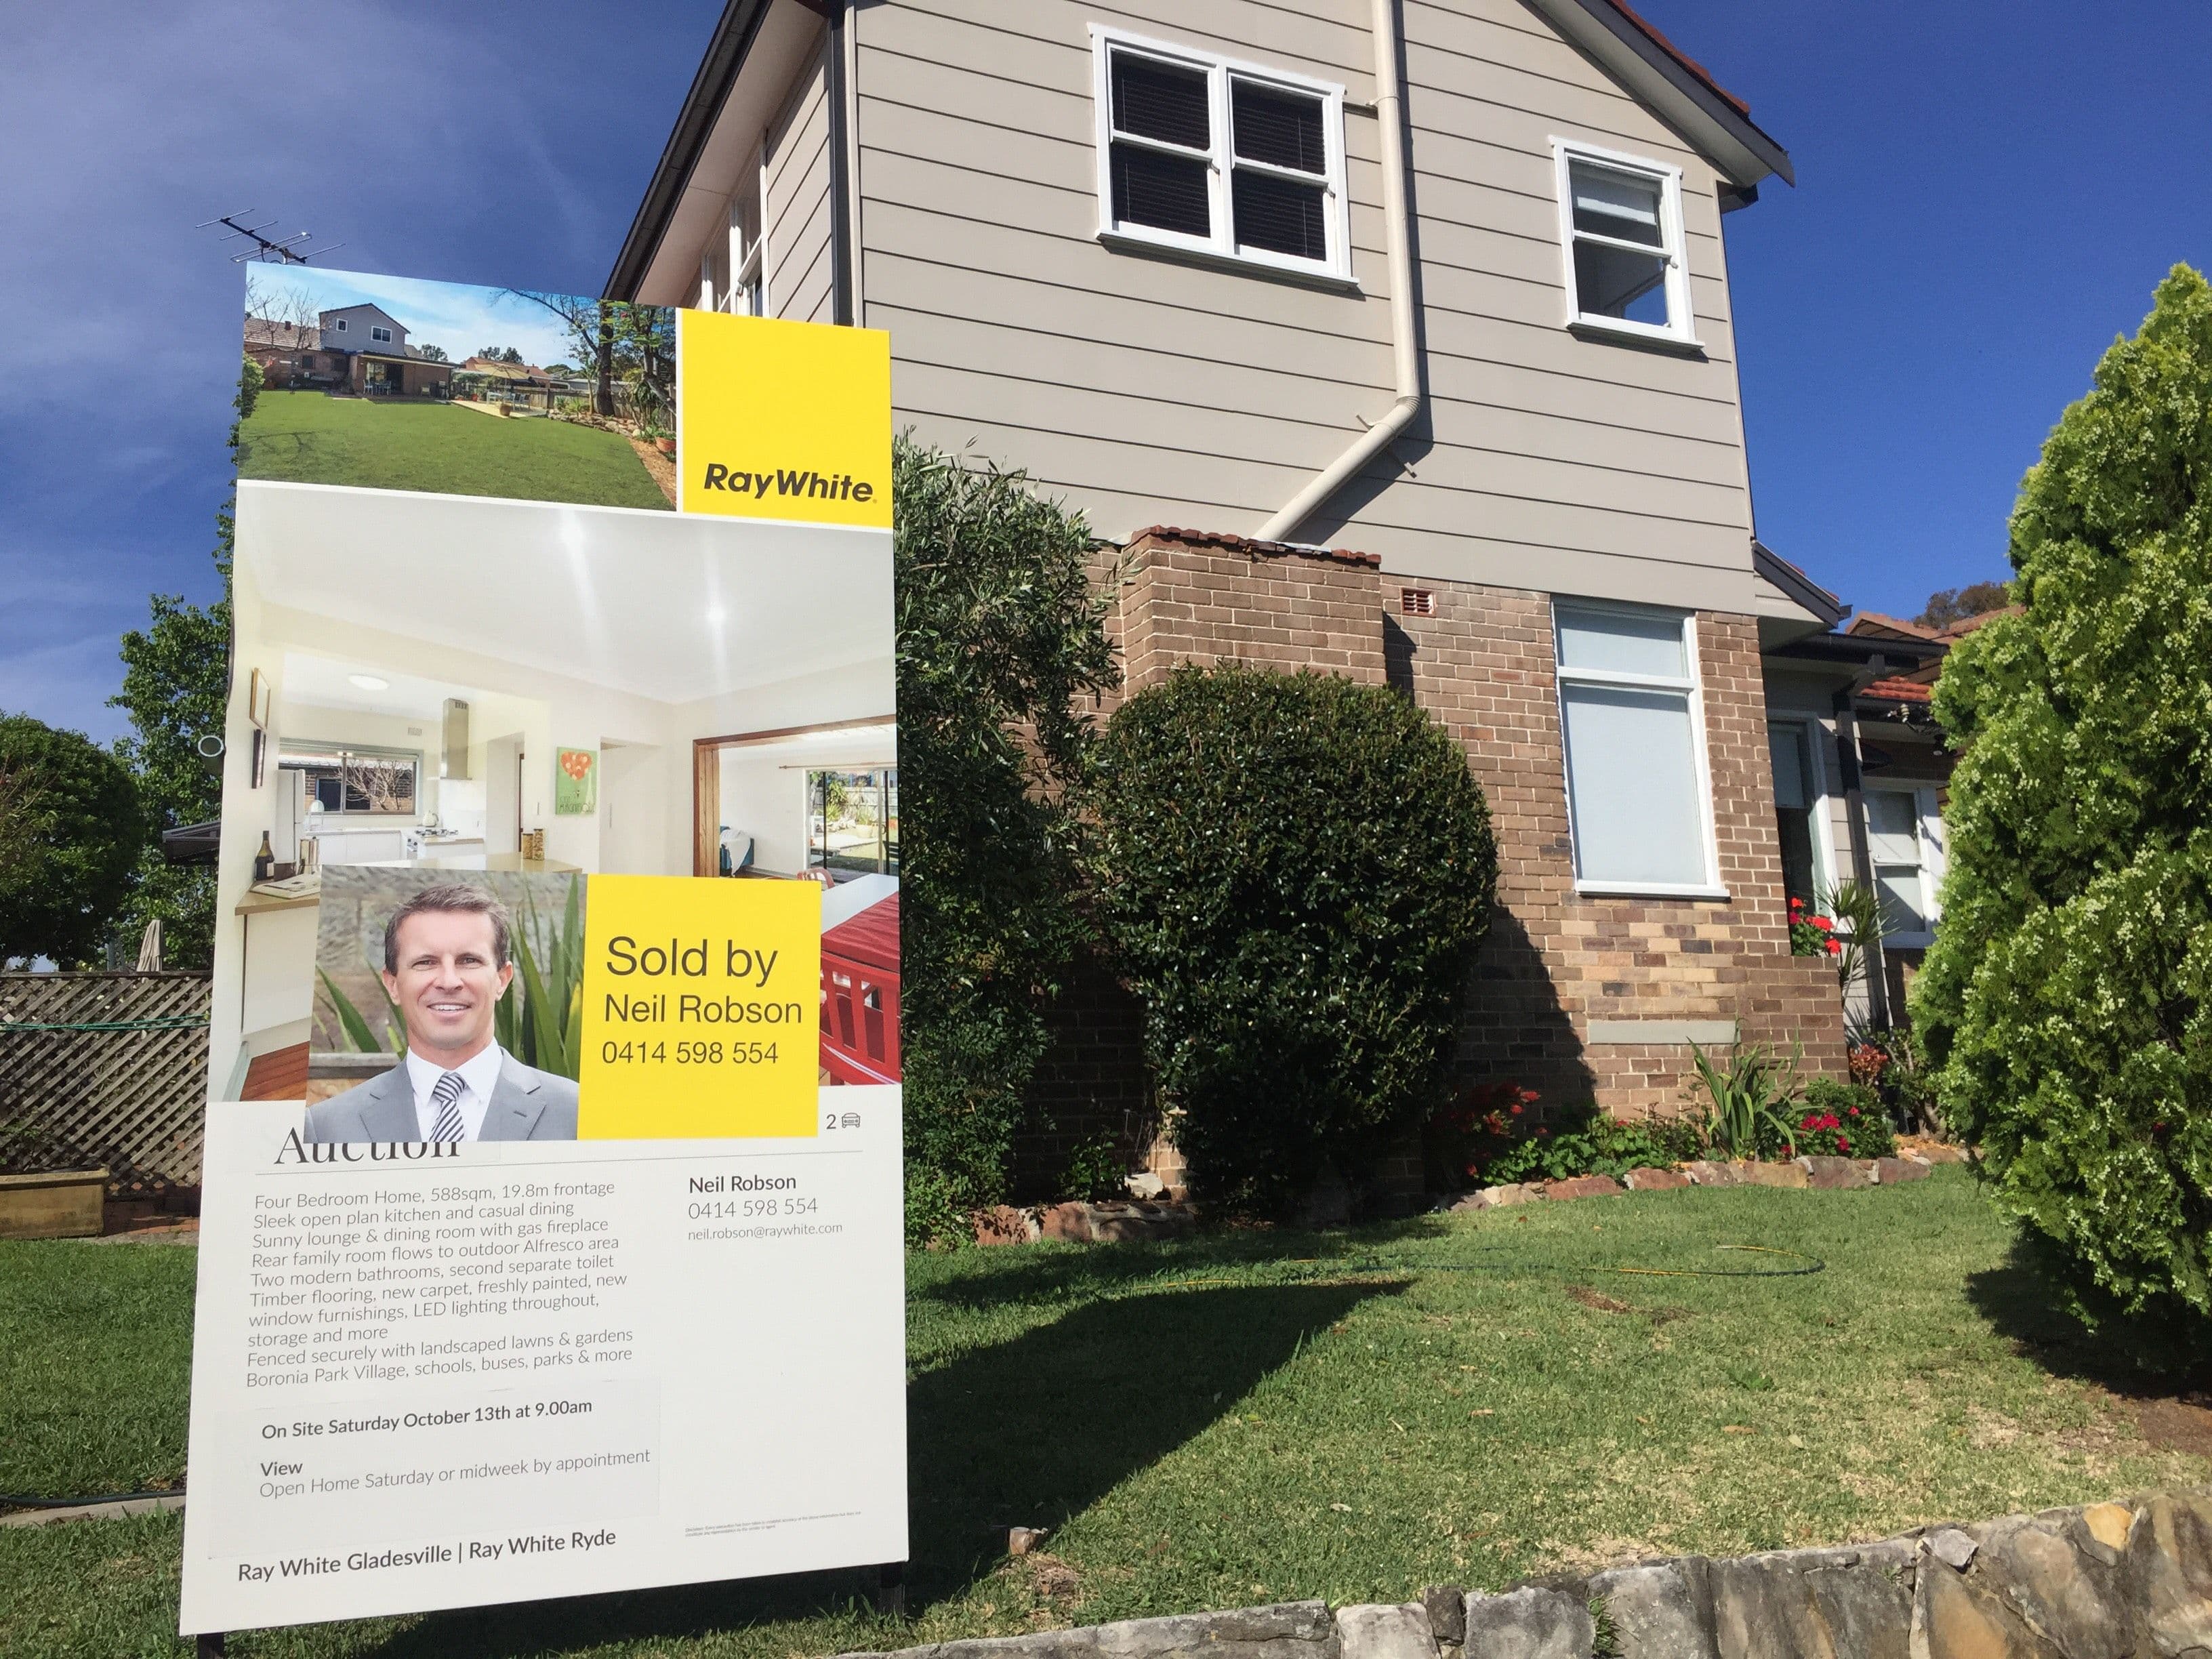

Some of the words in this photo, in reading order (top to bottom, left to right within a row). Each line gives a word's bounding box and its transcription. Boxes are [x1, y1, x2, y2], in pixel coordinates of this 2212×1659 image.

[606, 935, 708, 977] Sold
[726, 939, 779, 988] by
[605, 993, 665, 1023] Neil
[679, 994, 802, 1023] Robson
[602, 1040, 667, 1064] 0414
[676, 1041, 723, 1064] 598
[732, 1042, 779, 1064] 554
[825, 1113, 837, 1130] 2
[255, 1195, 292, 1209] Four
[297, 1192, 369, 1208] Bedroom
[374, 1190, 425, 1204] Home,
[430, 1187, 495, 1203] 588sqm,
[501, 1183, 548, 1199] 19.8m
[553, 1182, 615, 1197] frontage
[689, 1175, 724, 1193] Neil
[731, 1174, 796, 1191] Robson
[253, 1212, 295, 1229] Sleek
[300, 1214, 341, 1229] open
[346, 1210, 379, 1227] plan
[384, 1207, 441, 1223] kitchen
[445, 1204, 474, 1220] and
[478, 1202, 524, 1218] casual
[529, 1201, 574, 1217] dining
[688, 1201, 737, 1220] 0414
[743, 1199, 777, 1217] 598
[784, 1197, 818, 1215] 554
[252, 1233, 303, 1250] Sunny
[307, 1231, 361, 1247] lounge
[365, 1228, 378, 1243] &
[383, 1226, 430, 1243] dining
[436, 1227, 475, 1239] room
[480, 1221, 512, 1237] with
[516, 1224, 542, 1238] gas
[547, 1218, 609, 1235] fireplace
[688, 1223, 842, 1240] neil.robson@raywhite.com
[252, 1253, 289, 1268] Rear
[292, 1249, 341, 1267] family
[345, 1250, 386, 1263] room
[391, 1246, 433, 1261] flows
[438, 1245, 453, 1258] to
[458, 1241, 520, 1257] outdoor
[523, 1238, 583, 1253] Alfresco
[588, 1238, 619, 1250] area
[250, 1273, 285, 1287] Two
[290, 1269, 352, 1286] modern
[357, 1266, 444, 1282] bathrooms,
[449, 1259, 504, 1277] second
[508, 1257, 572, 1275] separate
[576, 1254, 614, 1269] toilet
[249, 1291, 307, 1307] Timber
[311, 1287, 376, 1304] flooring,
[382, 1288, 415, 1300] new
[419, 1282, 472, 1299] carpet,
[478, 1277, 529, 1294] freshly
[532, 1273, 591, 1294] painted,
[596, 1275, 628, 1286] new
[248, 1311, 313, 1327] window
[318, 1306, 407, 1323] furnishings,
[413, 1301, 446, 1317] LED
[451, 1298, 507, 1317] lighting
[512, 1293, 599, 1311] throughout,
[247, 1332, 308, 1348] storage
[312, 1327, 342, 1343] and
[348, 1328, 388, 1340] more
[247, 1349, 306, 1367] Fenced
[311, 1345, 377, 1364] securely
[381, 1342, 415, 1358] with
[421, 1335, 506, 1355] landscaped
[512, 1334, 554, 1349] lawns
[558, 1331, 571, 1346] &
[575, 1328, 633, 1348] gardens
[246, 1369, 308, 1387] Boronia
[314, 1366, 348, 1382] Park
[353, 1364, 409, 1381] Village,
[414, 1357, 476, 1376] schools,
[481, 1356, 528, 1371] buses,
[533, 1351, 573, 1370] parks
[577, 1349, 590, 1364] &
[594, 1349, 632, 1362] more
[262, 1424, 287, 1439] On
[292, 1421, 323, 1437] Site
[328, 1415, 400, 1434] Saturday
[403, 1410, 470, 1428] October
[474, 1405, 510, 1422] 13th
[515, 1404, 531, 1418] at
[535, 1400, 592, 1416] 9.00am
[260, 1461, 303, 1477] View
[260, 1482, 305, 1500] Open
[311, 1477, 360, 1493] Home
[365, 1469, 434, 1488] Saturday
[438, 1469, 455, 1481] or
[459, 1459, 529, 1479] midweek
[533, 1458, 552, 1475] by
[555, 1448, 651, 1473] appointment
[238, 1563, 275, 1583] Ray
[279, 1556, 341, 1577] White
[347, 1544, 452, 1571] Gladesville
[469, 1541, 504, 1560] Ray
[507, 1534, 565, 1555] White
[571, 1528, 616, 1551] Ryde
